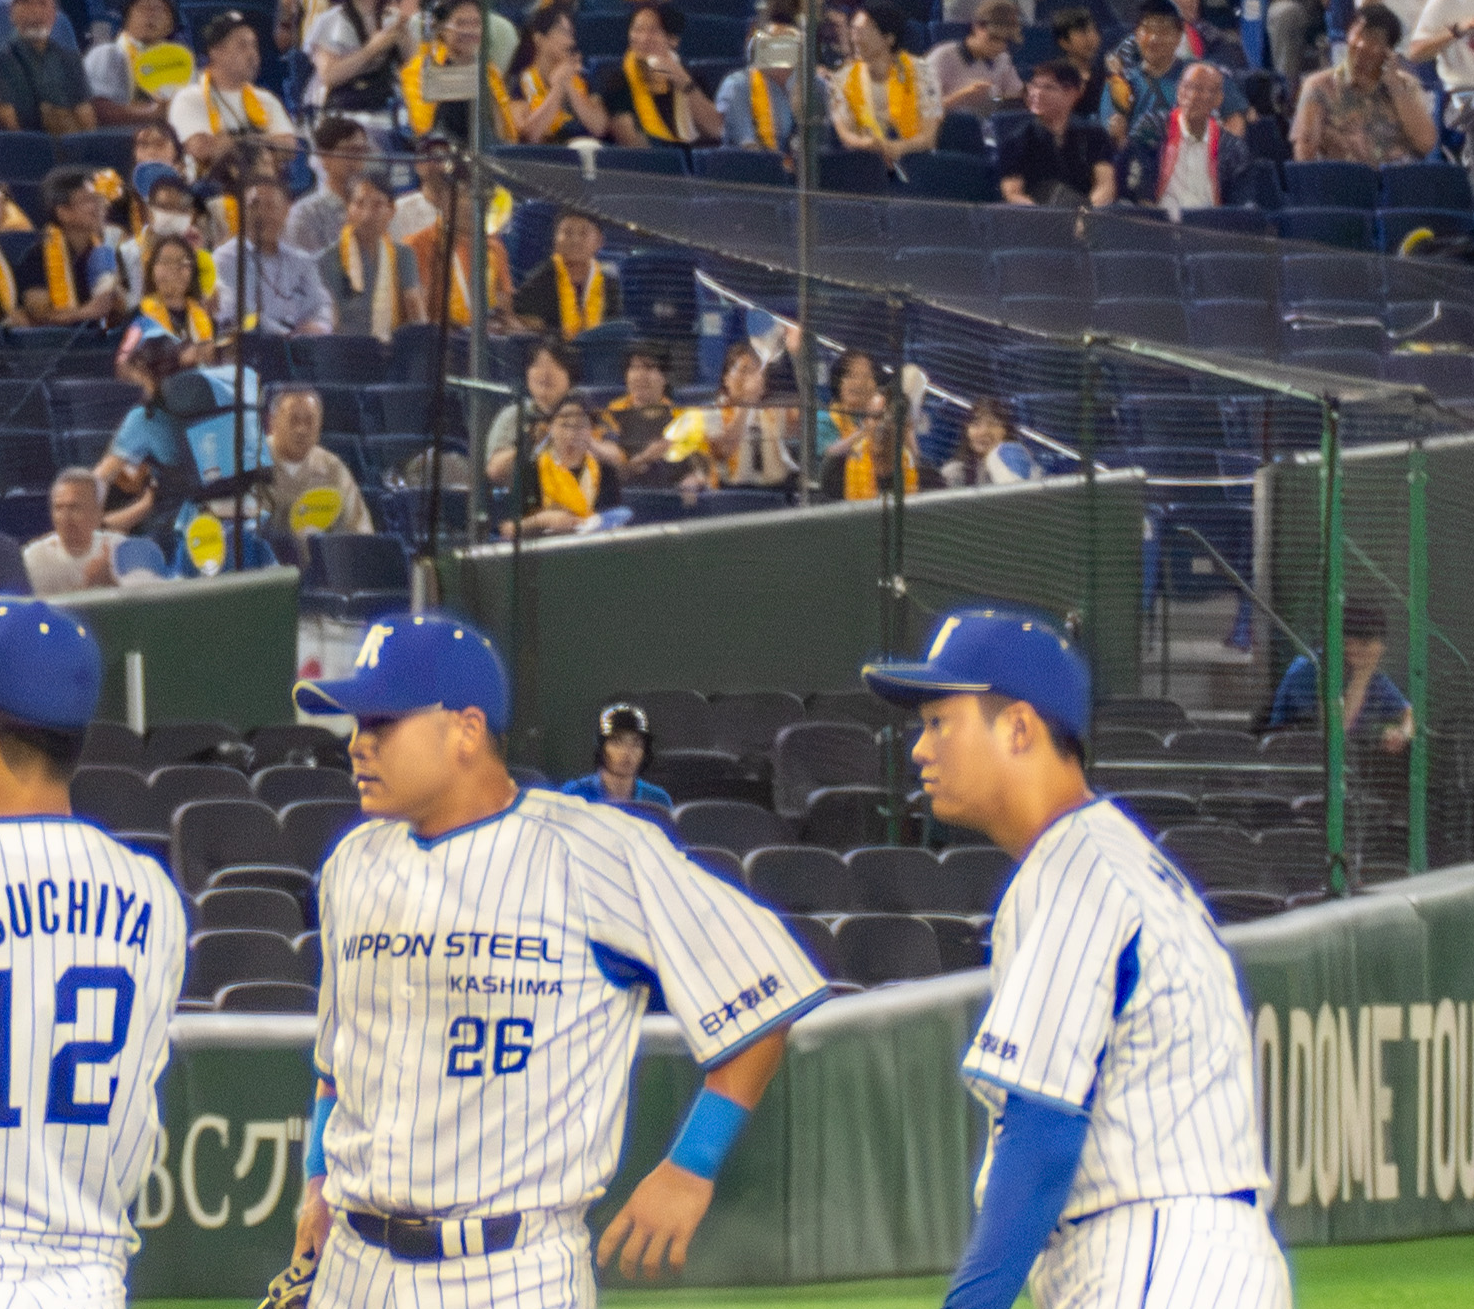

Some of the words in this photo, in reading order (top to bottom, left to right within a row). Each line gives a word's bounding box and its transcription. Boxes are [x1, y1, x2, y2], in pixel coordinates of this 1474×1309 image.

[341, 932, 436, 962] NIPPON
[444, 931, 564, 964] STEEL
[449, 974, 564, 998] KASHIMA
[446, 1015, 534, 1078] 26
[1288, 1000, 1403, 1208] DOME
